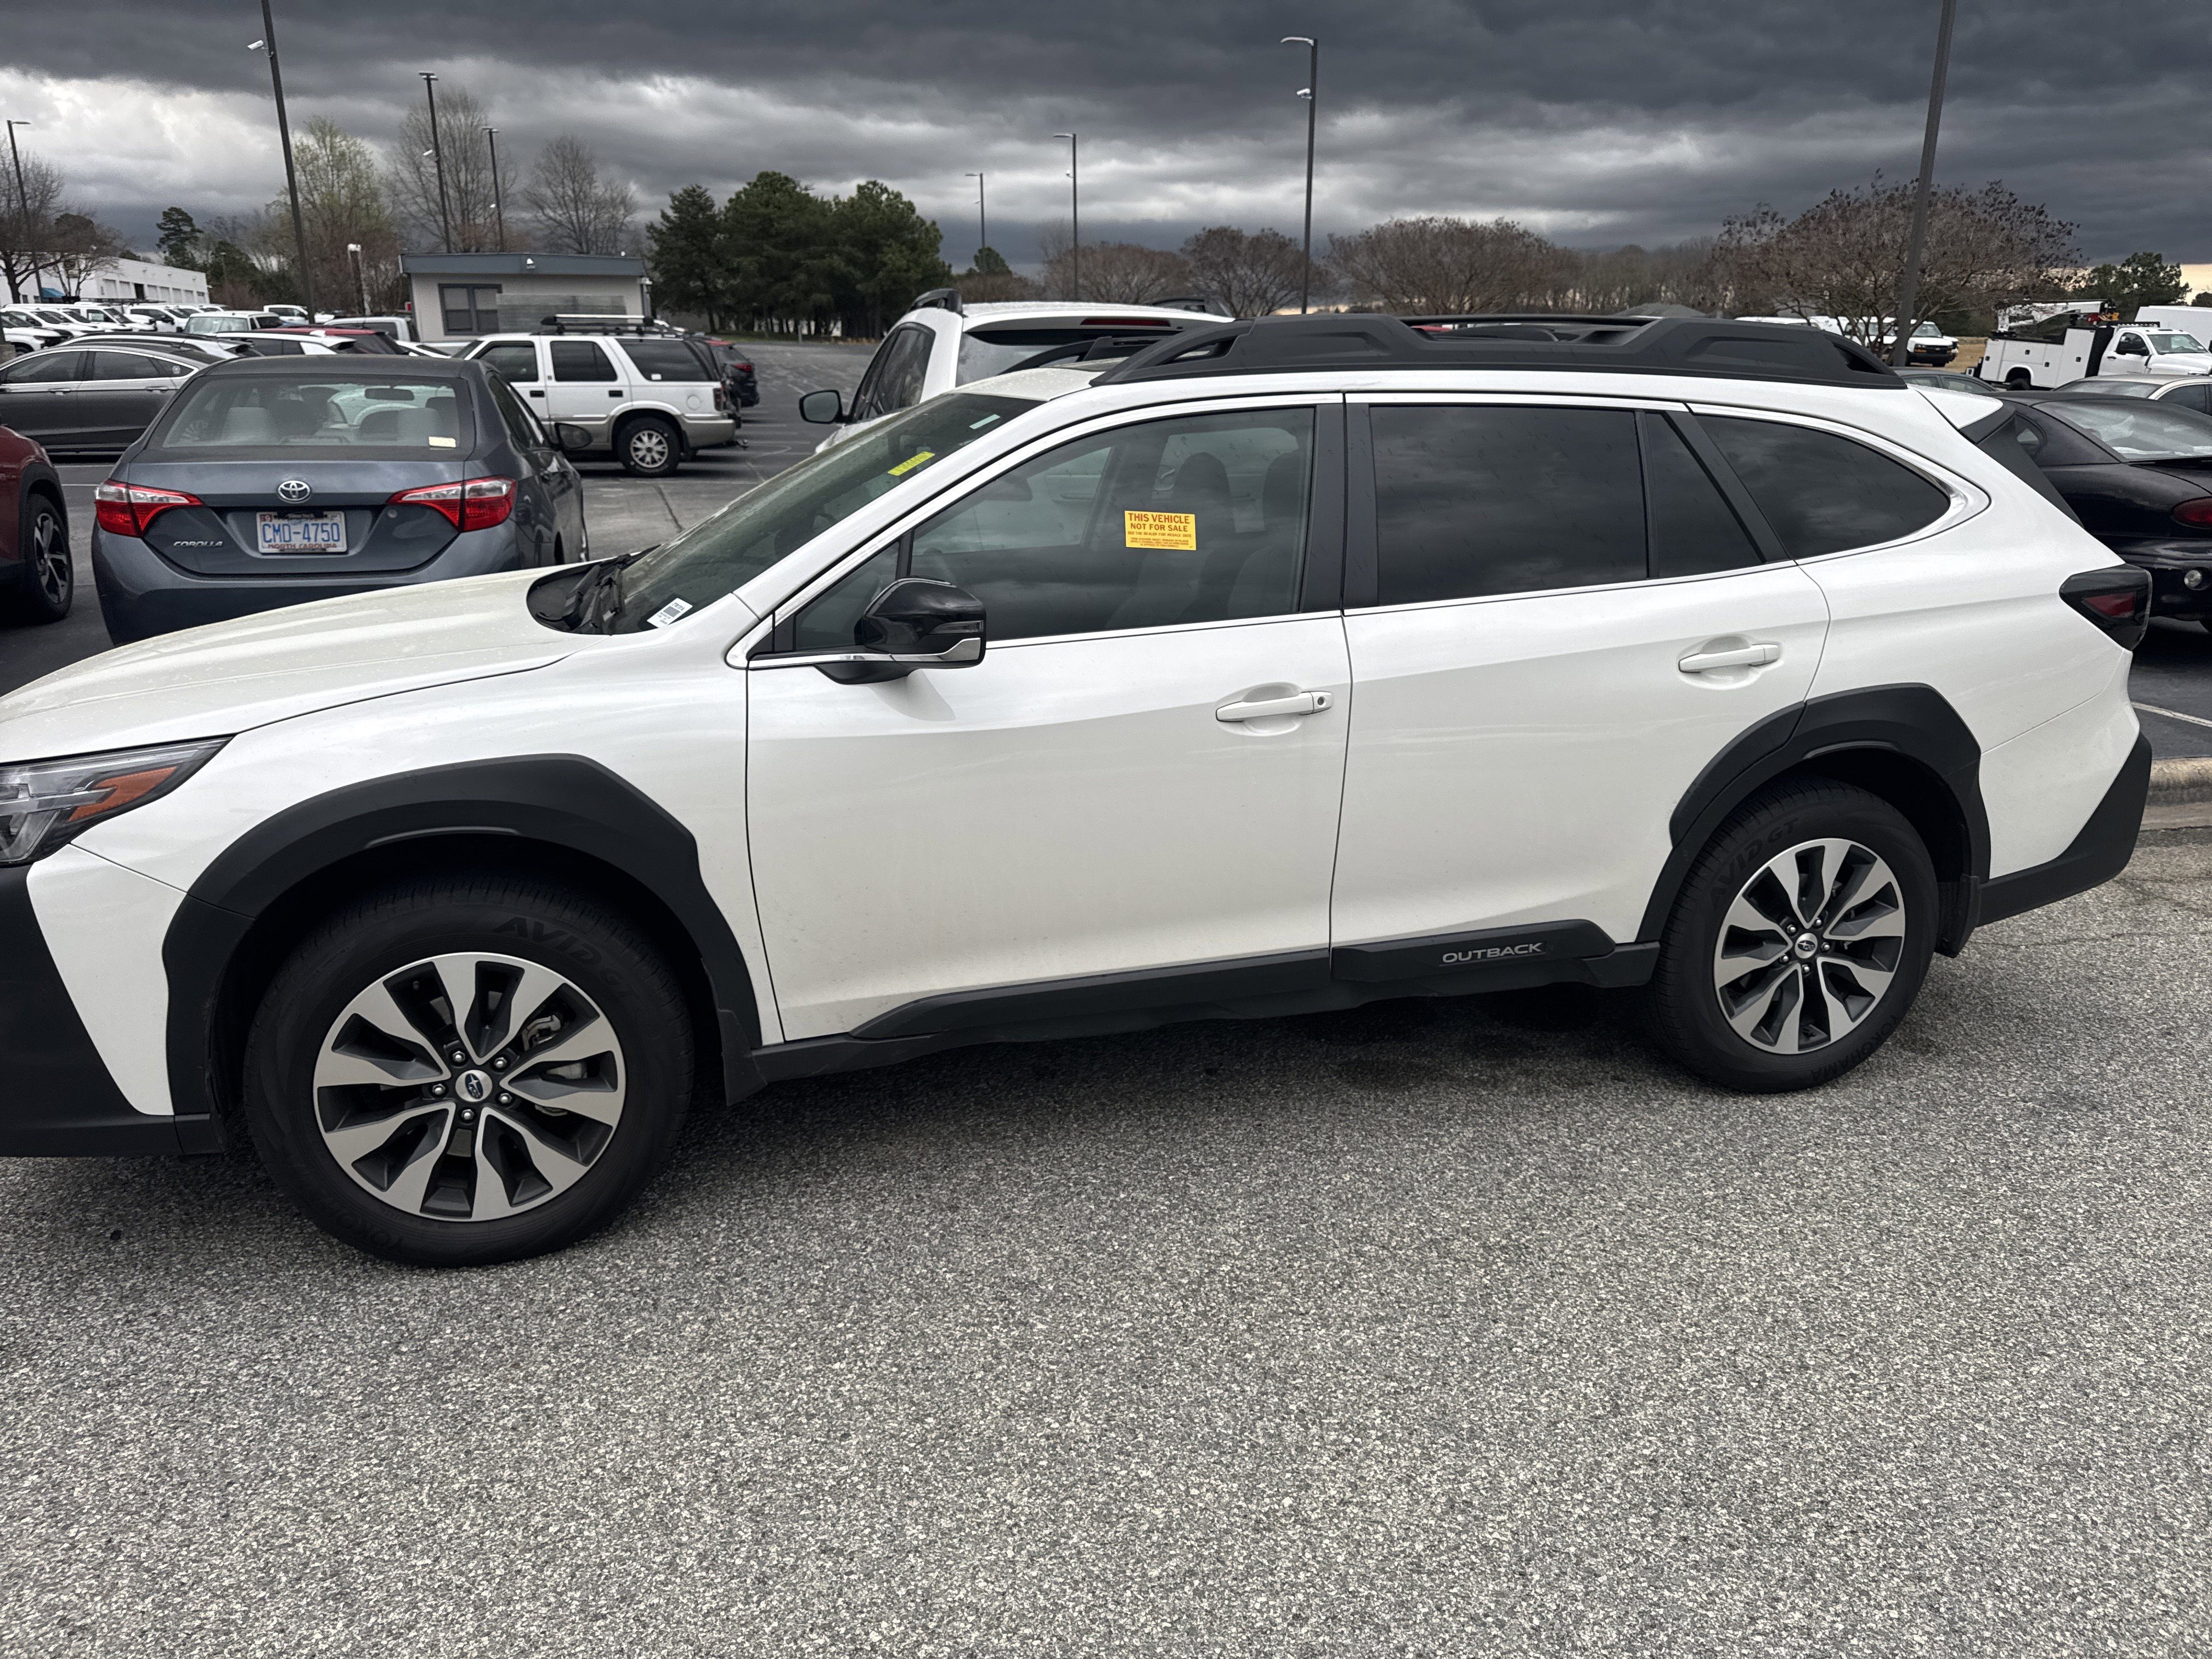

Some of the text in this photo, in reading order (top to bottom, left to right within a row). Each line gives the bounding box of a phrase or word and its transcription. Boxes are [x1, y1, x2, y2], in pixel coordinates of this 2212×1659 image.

[1128, 513, 1190, 524] THIS VEHICLE
[262, 523, 340, 543] CMD-4750
[491, 917, 602, 965] AVID
[1442, 943, 1542, 963] OUTBACK
